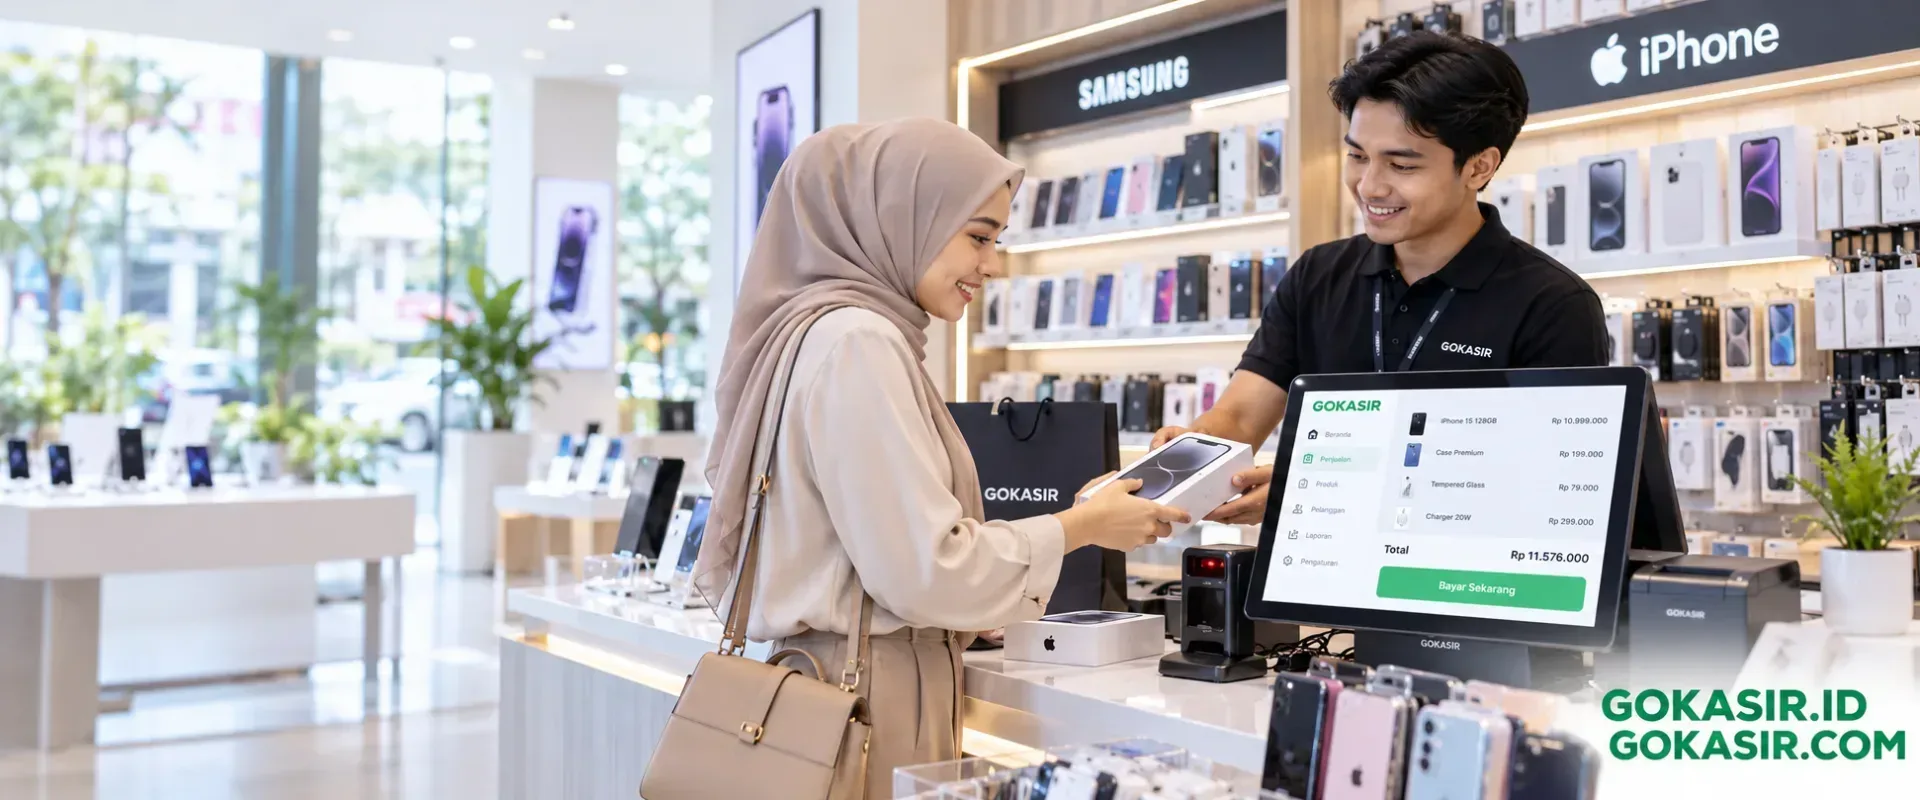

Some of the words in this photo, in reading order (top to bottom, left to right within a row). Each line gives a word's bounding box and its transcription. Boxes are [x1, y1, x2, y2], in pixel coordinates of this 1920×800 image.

[1639, 22, 1780, 77] iPhone
[1078, 55, 1190, 111] SAMSUNG
[1440, 341, 1493, 358] GOKASIR
[1312, 400, 1382, 412] GOKASIR
[1551, 417, 1562, 425] Rp
[1564, 417, 1608, 425] 10.999.000
[1559, 450, 1570, 459] Rp
[1572, 450, 1604, 458] 199.000
[1315, 480, 1338, 488] Produk
[1431, 480, 1465, 488] Tempered
[1466, 481, 1485, 489] Glass
[1558, 484, 1569, 492] Rp
[1571, 484, 1599, 492] 79.000
[984, 487, 1059, 503] GOKASIR
[1310, 505, 1346, 515] Pelanggan
[1425, 513, 1453, 521] Charger
[1548, 517, 1559, 526] Rp
[1560, 518, 1594, 526] 299.000
[1305, 532, 1333, 540] Laporan
[1384, 544, 1410, 555] Total
[1300, 557, 1339, 567] Pengaturan
[1510, 550, 1526, 561] Rp
[1528, 551, 1590, 564] 11.576.000
[1438, 580, 1467, 592] Bayar
[1468, 583, 1516, 597] Sekarang
[1666, 608, 1706, 619] GOKASIR
[1420, 639, 1461, 650] GOKASIR
